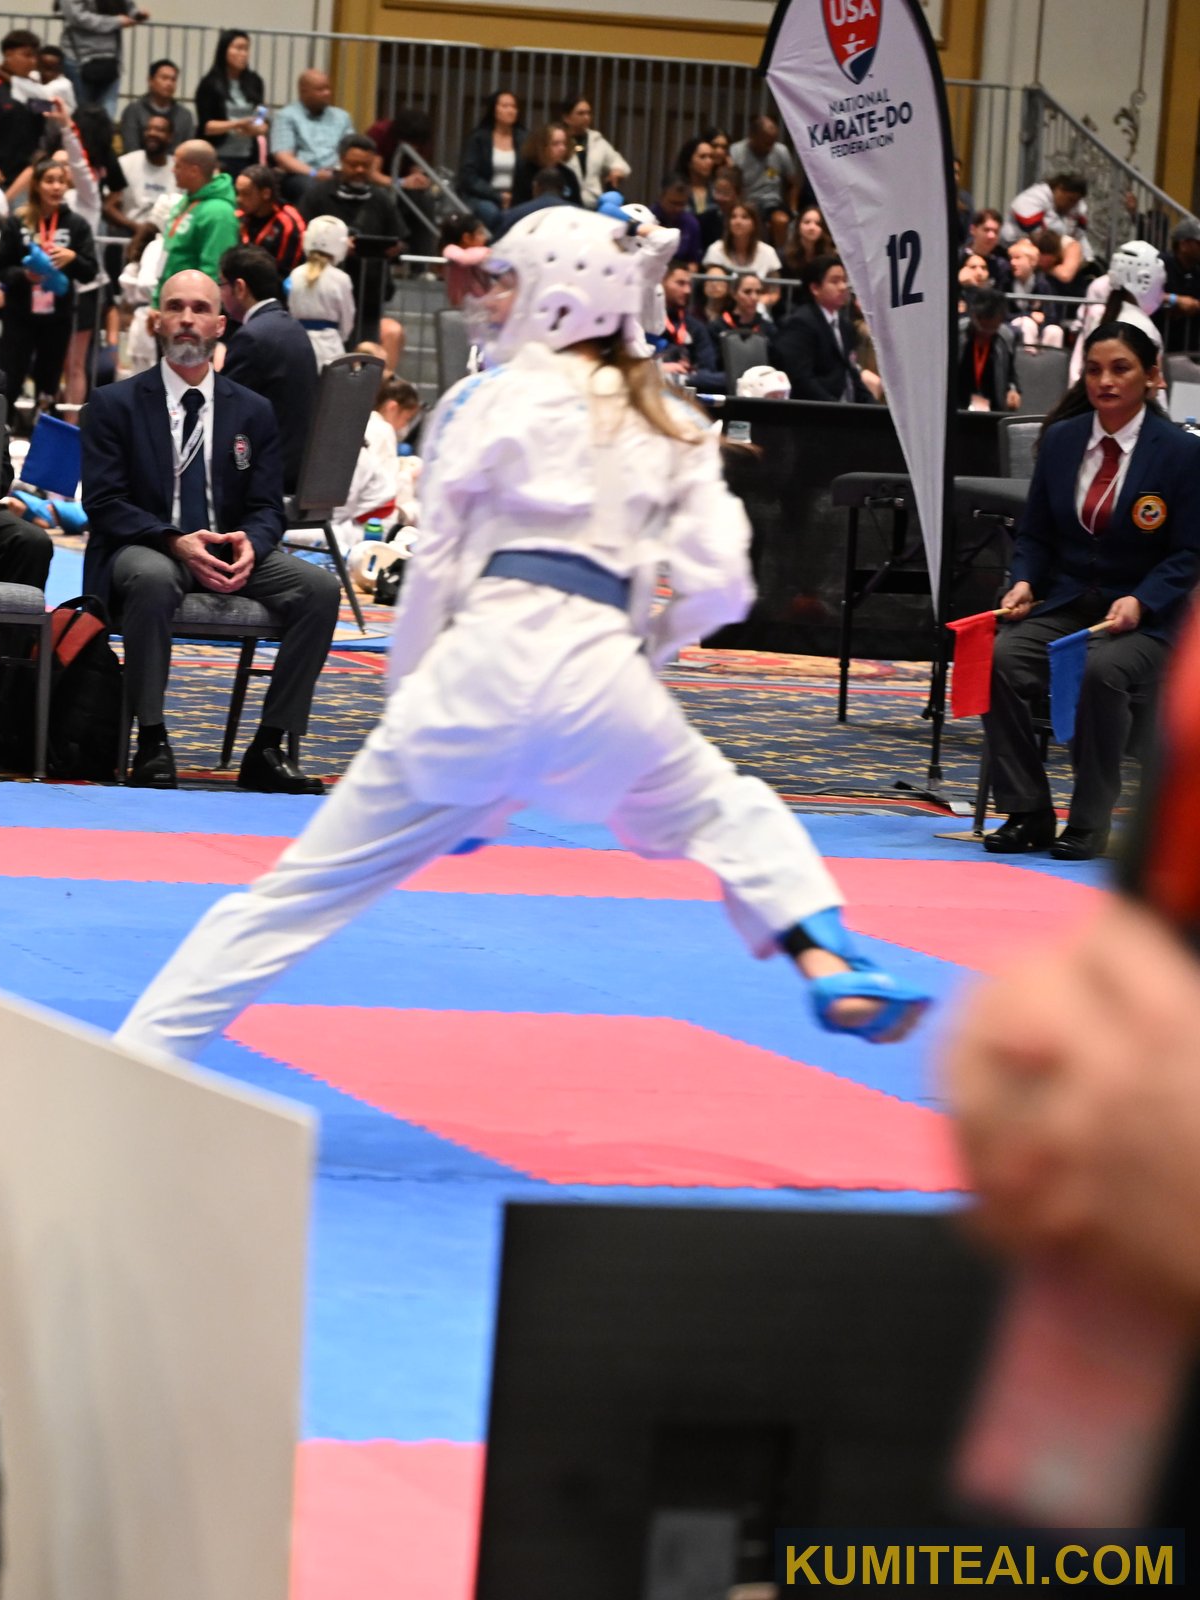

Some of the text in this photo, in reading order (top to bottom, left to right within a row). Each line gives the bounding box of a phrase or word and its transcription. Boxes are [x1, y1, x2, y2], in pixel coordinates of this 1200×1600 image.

[829, 0, 876, 26] USA
[829, 89, 890, 115] NATIONAL
[808, 101, 913, 148] KARATE-DO
[830, 133, 894, 159] FEDERATION
[885, 230, 924, 308] 12
